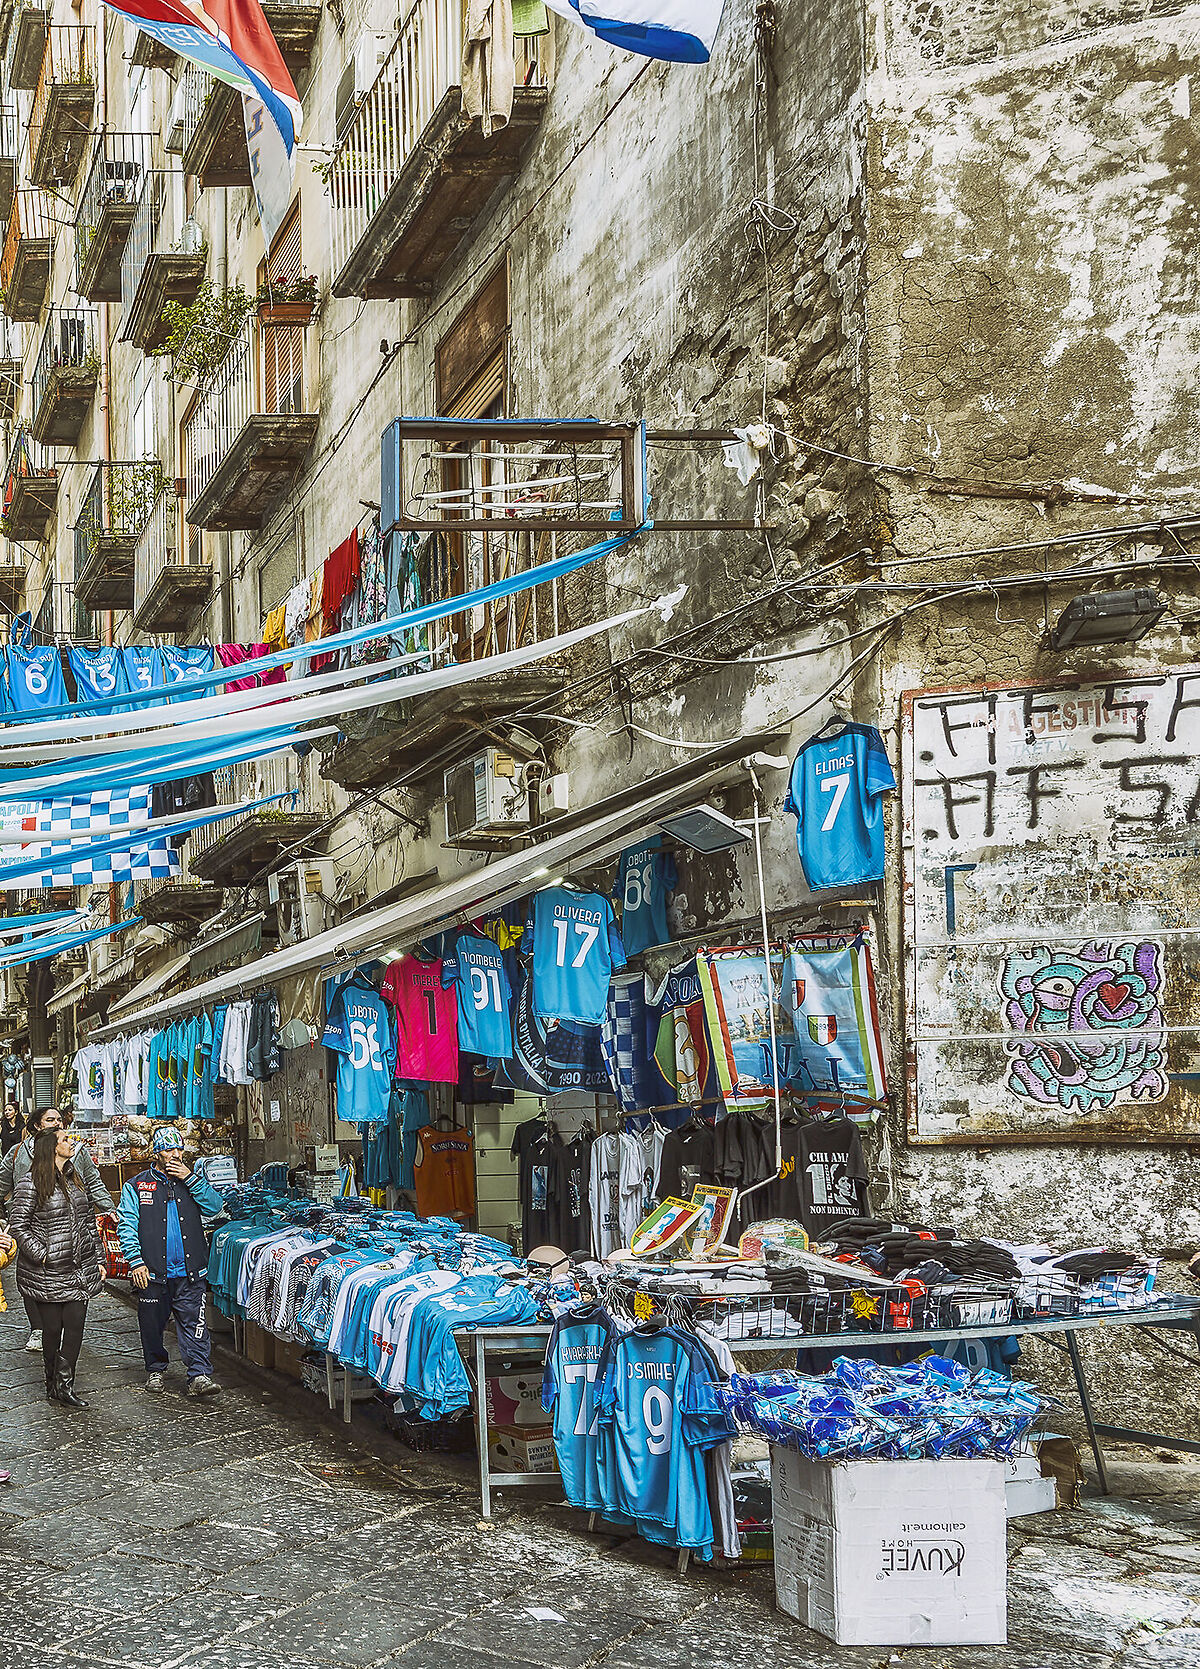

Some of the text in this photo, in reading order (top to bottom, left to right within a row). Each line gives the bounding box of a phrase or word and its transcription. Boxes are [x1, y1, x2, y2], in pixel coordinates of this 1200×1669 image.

[25, 663, 48, 695] 6
[84, 662, 116, 692] 13
[136, 667, 152, 690] 3
[815, 754, 855, 776] ELMAS
[820, 775, 850, 832] 7
[553, 904, 602, 924] OLIVERA
[553, 919, 600, 968] 17
[470, 966, 503, 1012] 91
[422, 989, 438, 1035] 1
[324, 1024, 342, 1035] azon
[519, 1023, 544, 1068] D'ITALIA
[809, 1152, 829, 1163] CHI
[810, 1205, 826, 1215] NON
[643, 1385, 672, 1456] 9
[527, 1445, 554, 1455] ANANAS
[902, 1523, 966, 1532] calhome.it
[881, 1539, 913, 1548] HOME
